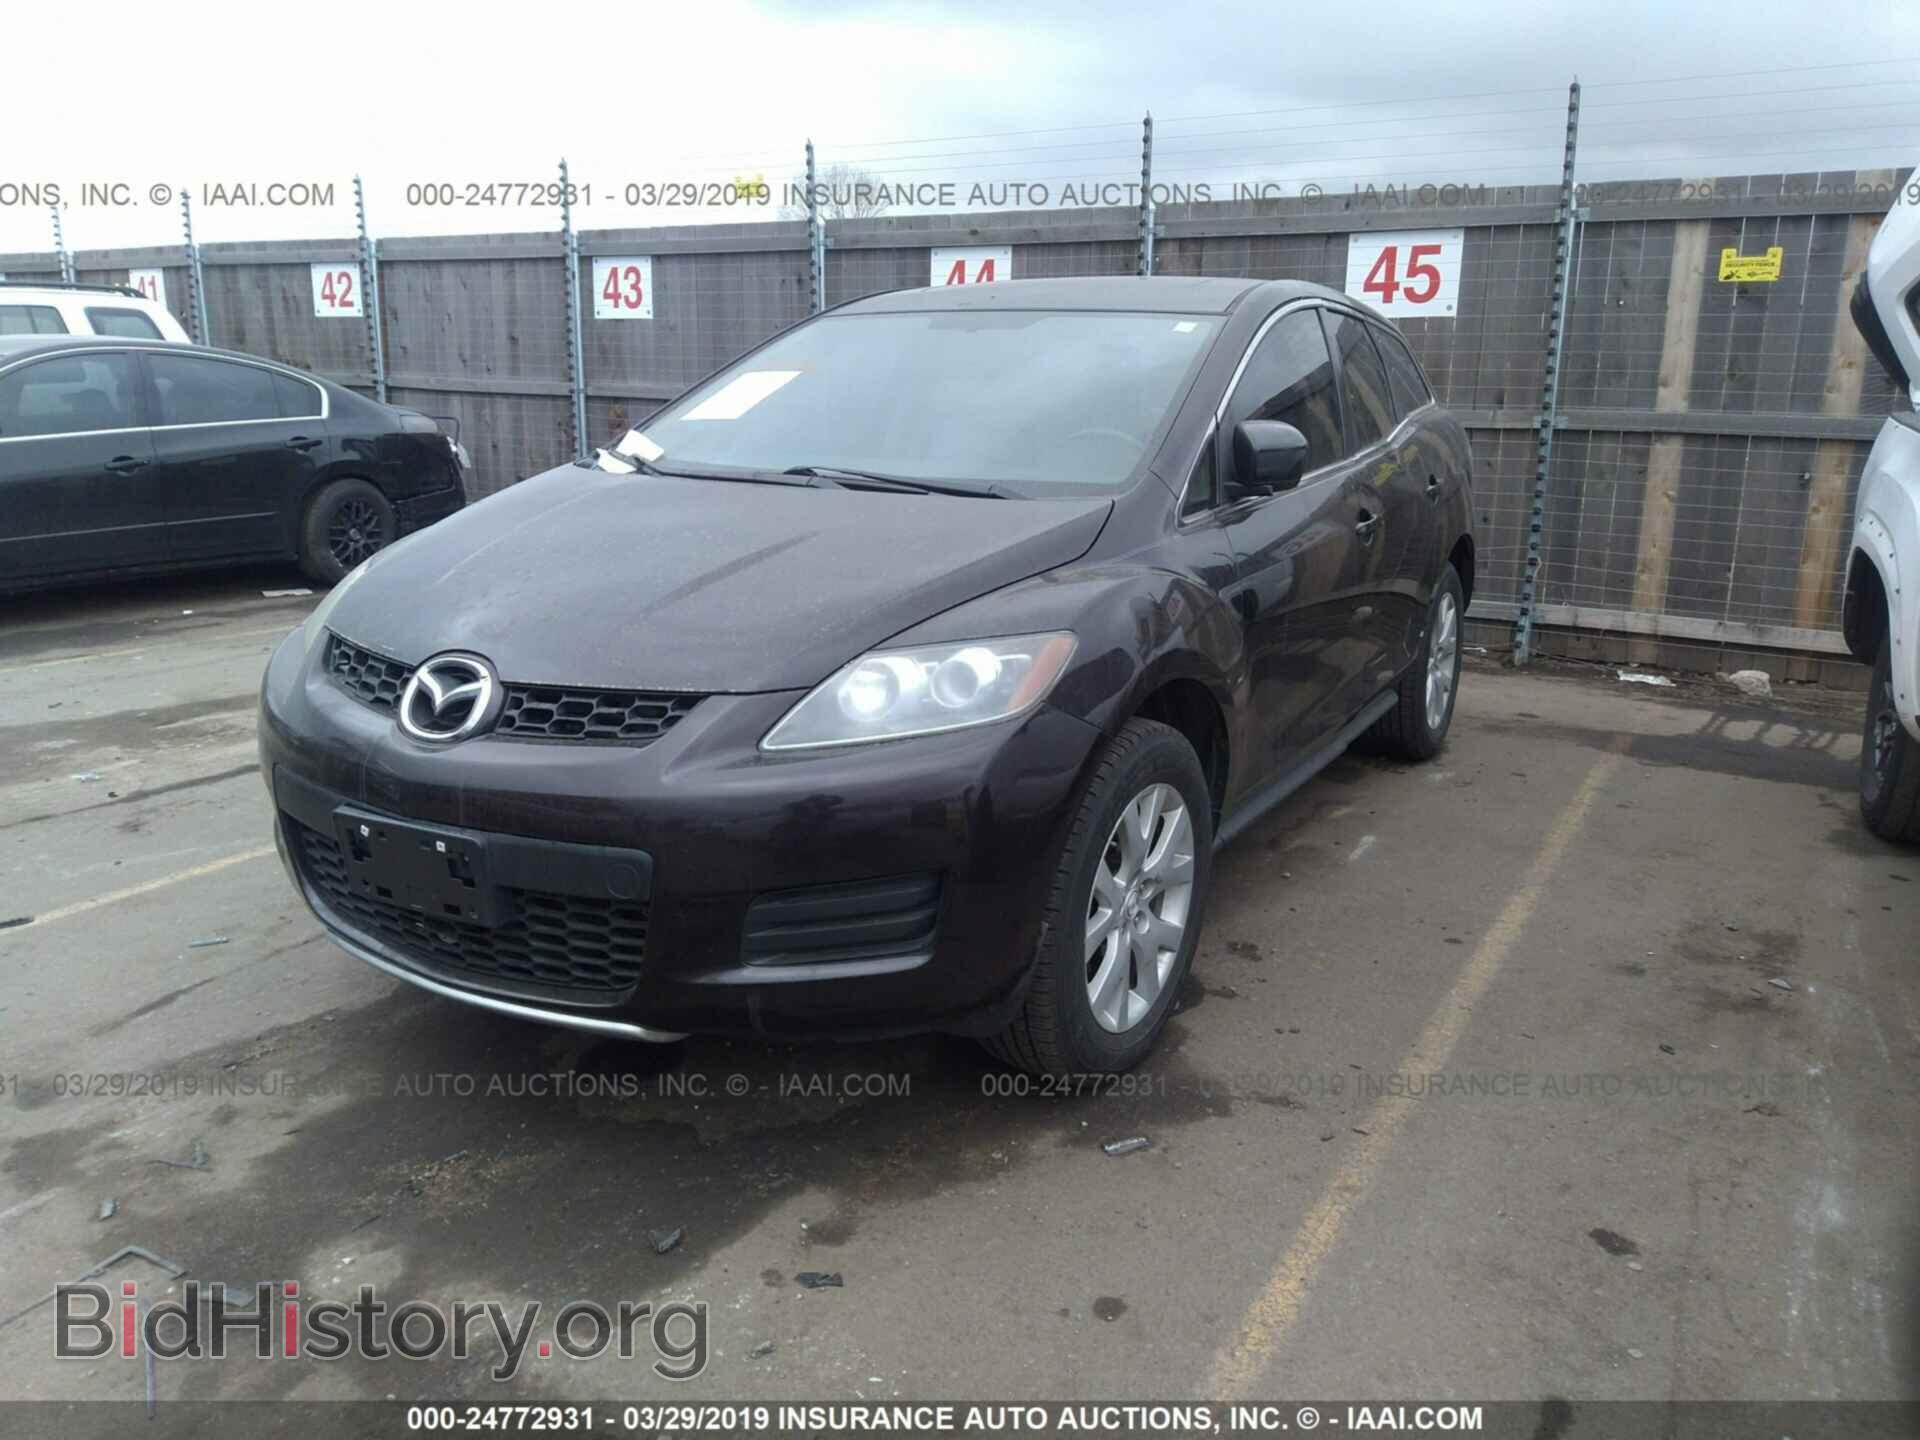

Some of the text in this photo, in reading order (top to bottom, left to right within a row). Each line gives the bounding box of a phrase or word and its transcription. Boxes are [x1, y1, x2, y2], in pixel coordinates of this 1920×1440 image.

[321, 272, 354, 308] 42
[603, 266, 643, 309] 43
[1363, 244, 1442, 304] 45
